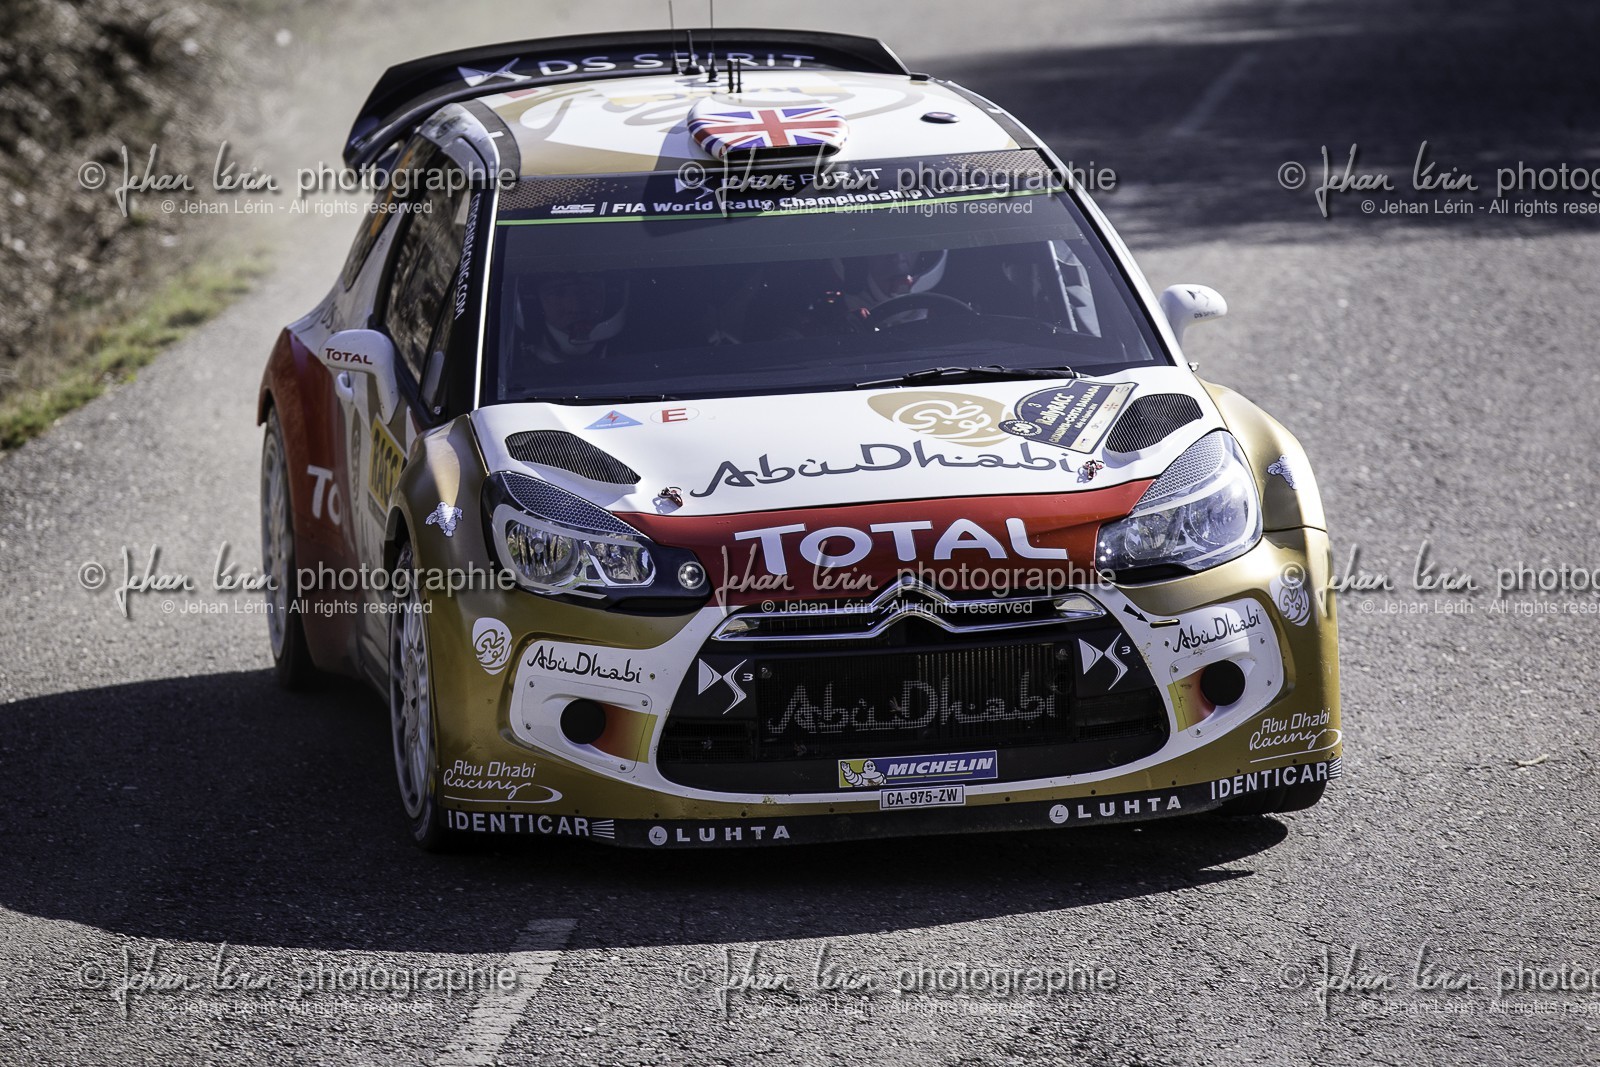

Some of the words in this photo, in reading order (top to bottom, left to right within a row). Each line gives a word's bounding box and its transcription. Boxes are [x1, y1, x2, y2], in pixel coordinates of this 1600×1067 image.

[538, 57, 616, 76] DS
[612, 203, 646, 213] FIA
[653, 201, 713, 212] World
[720, 199, 775, 213] Rally
[780, 190, 922, 208] Championship
[325, 348, 373, 365] TOTAL
[661, 408, 688, 422] E
[734, 517, 1069, 576] TOTAL
[1261, 718, 1288, 735] Abu
[1290, 708, 1331, 730] Dhabi
[1250, 728, 1328, 751] Racing
[453, 759, 483, 777] Abu
[487, 761, 537, 778] Dhabi
[887, 757, 994, 776] MICHELIN
[443, 768, 532, 800] Racing
[1210, 762, 1328, 800] IDENTICAR
[887, 788, 958, 806] CA-975-ZW
[1077, 795, 1182, 819] LUHTA
[447, 809, 590, 837] IDENTICAR
[676, 825, 791, 842] LUHTA
